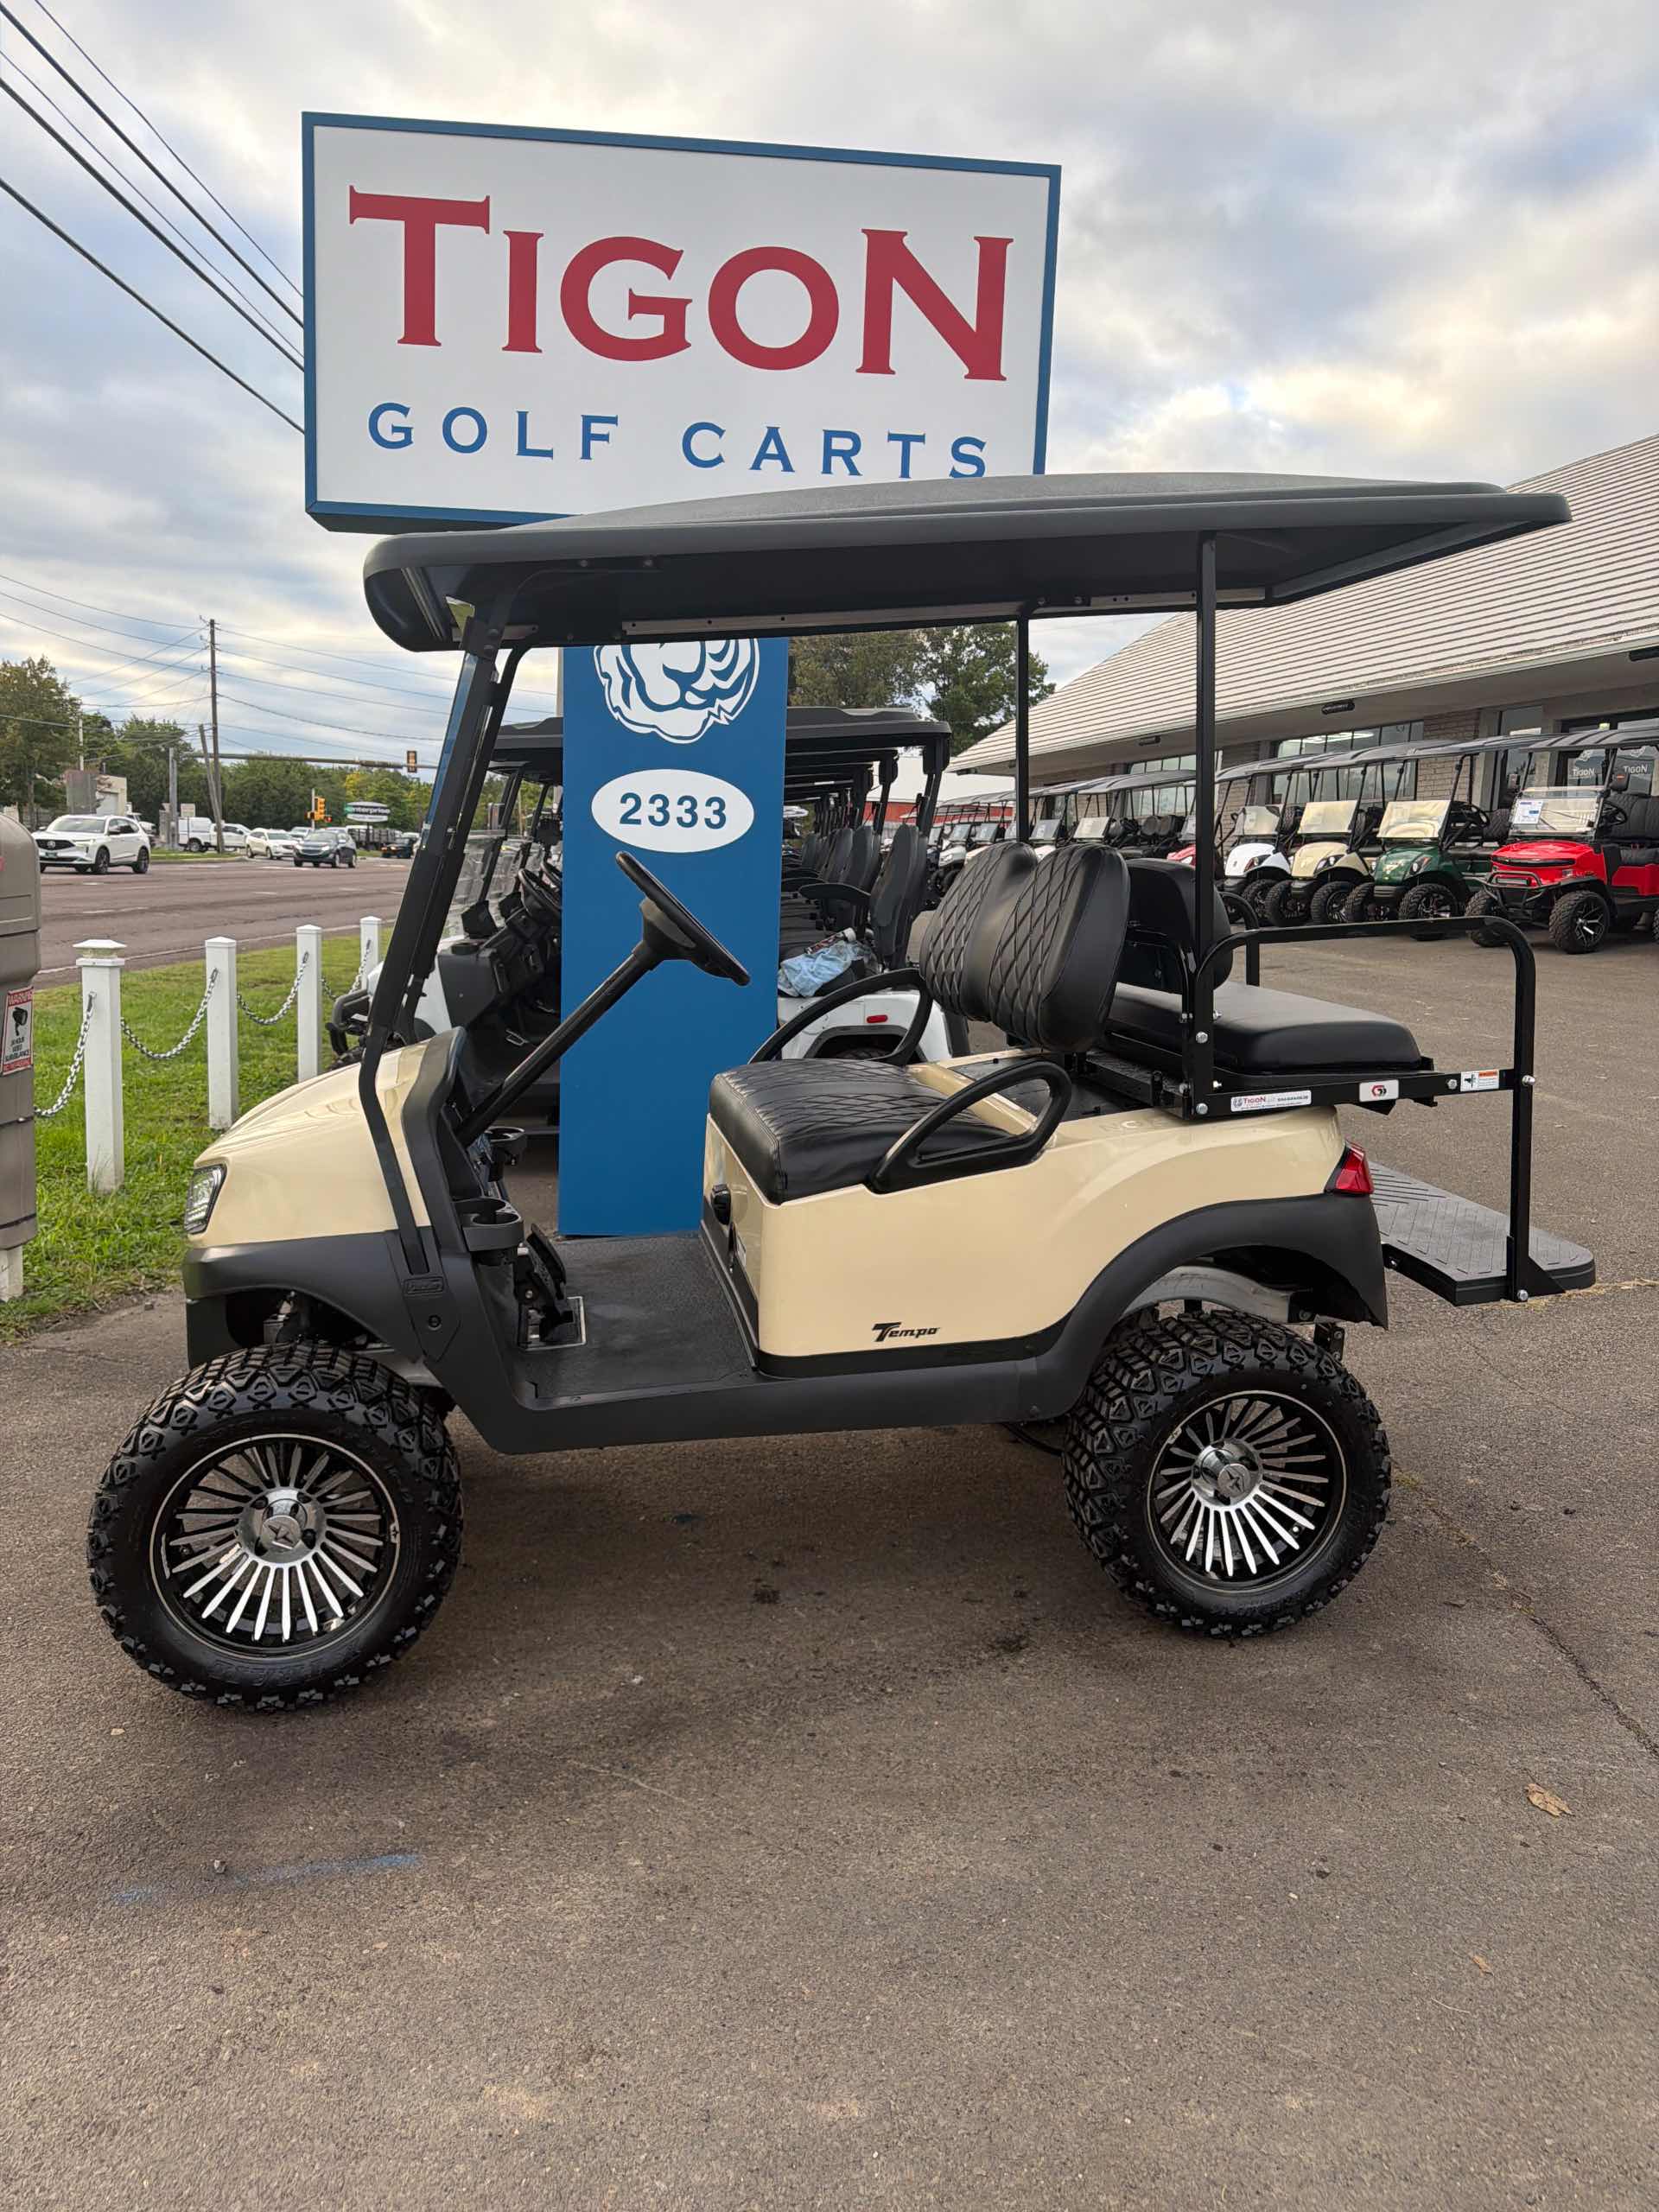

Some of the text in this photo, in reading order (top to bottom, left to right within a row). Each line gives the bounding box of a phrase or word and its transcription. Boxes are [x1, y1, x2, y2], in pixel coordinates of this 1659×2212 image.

[349, 184, 1014, 381] TIGON
[368, 402, 987, 479] GOLF CARTS
[1573, 768, 1595, 777] TIGON
[1624, 765, 1648, 774] TIGON
[620, 792, 727, 830] 2333
[872, 1322, 940, 1342] Tempo
